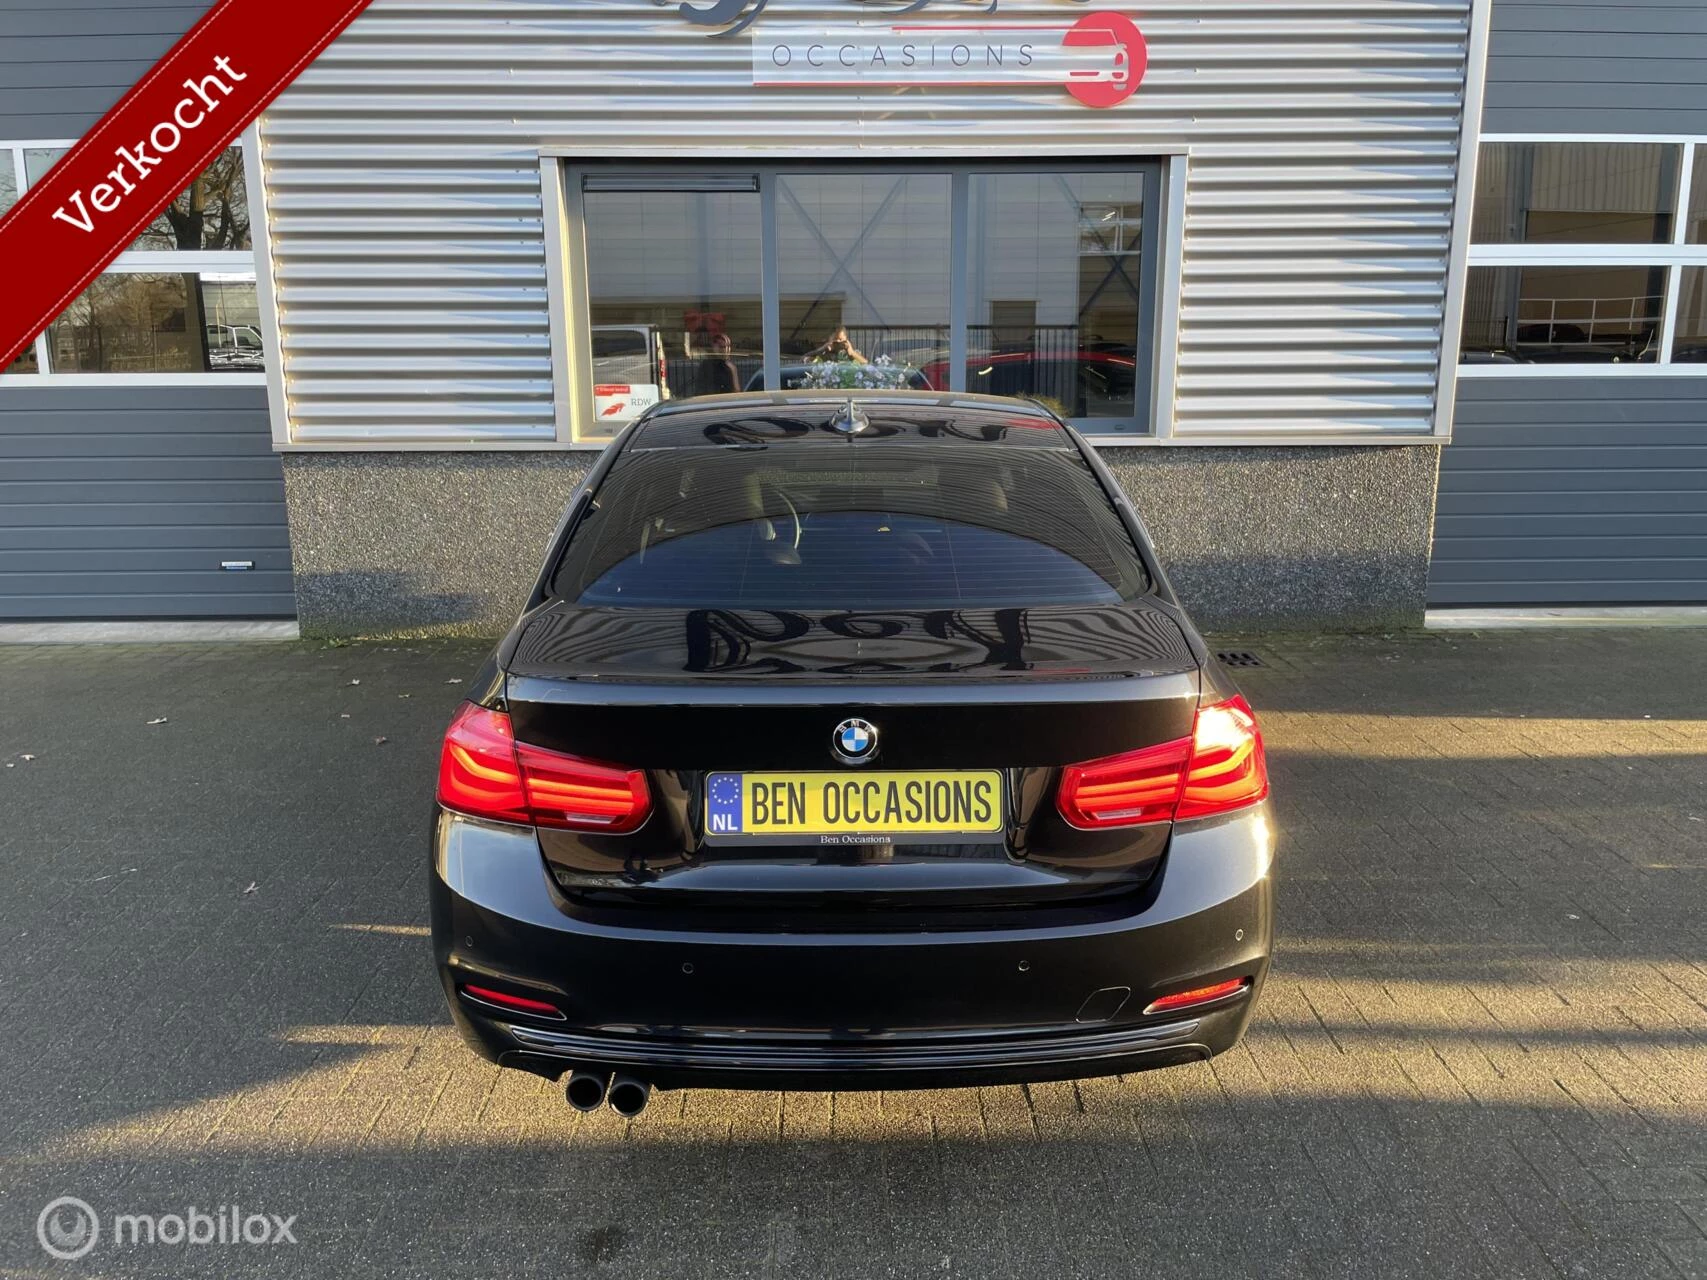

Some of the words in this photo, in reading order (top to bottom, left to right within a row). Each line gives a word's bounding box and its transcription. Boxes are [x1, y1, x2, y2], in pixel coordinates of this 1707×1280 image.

[771, 44, 1034, 67] OCCASIONS
[632, 398, 652, 406] RDW
[751, 781, 806, 825] BEN
[823, 780, 992, 824] OCCASIONS
[713, 814, 738, 831] NL
[820, 835, 840, 844] Ben
[841, 834, 891, 844] Occasions
